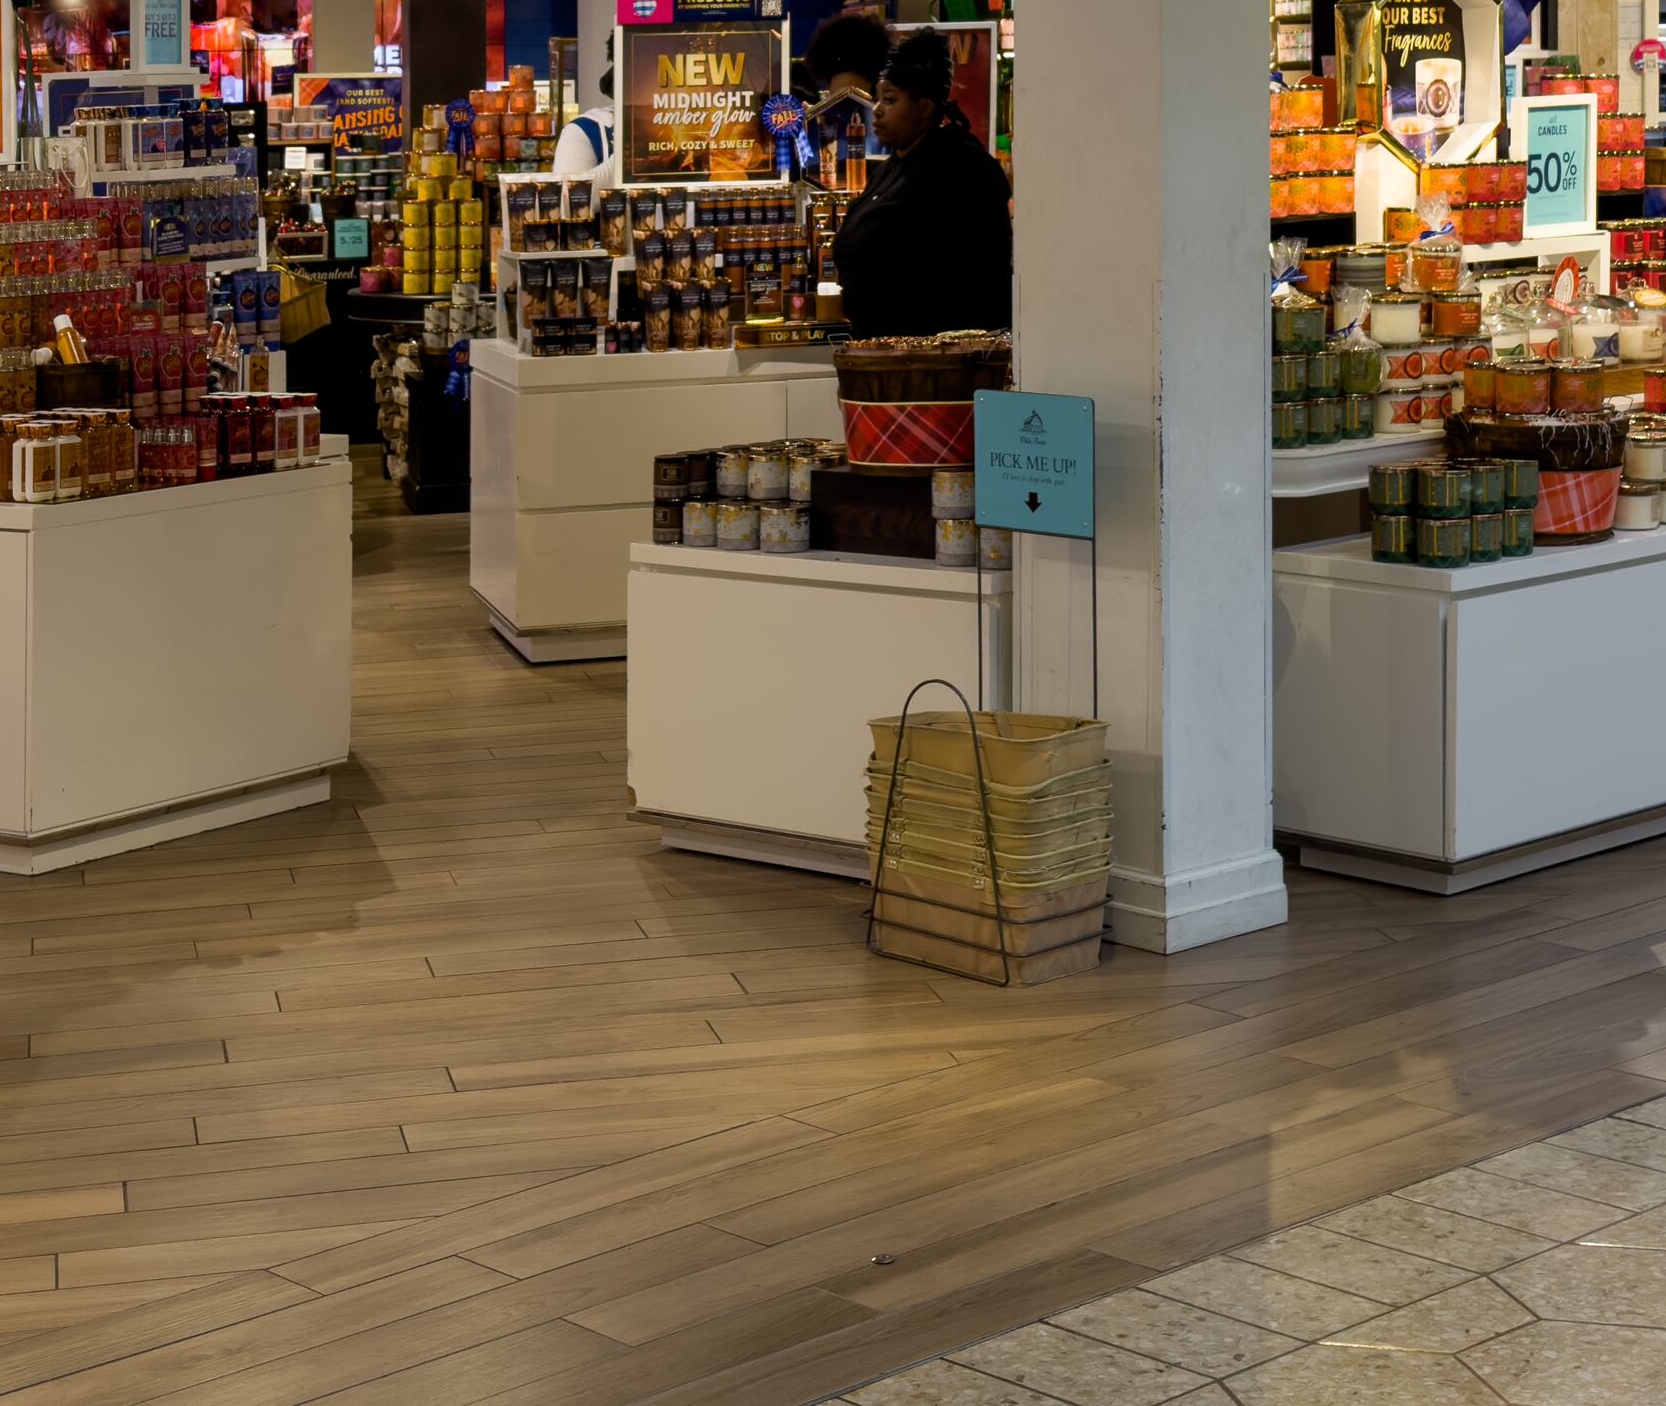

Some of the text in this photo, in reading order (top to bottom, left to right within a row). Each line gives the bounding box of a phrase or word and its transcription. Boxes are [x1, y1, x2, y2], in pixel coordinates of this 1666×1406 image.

[1382, 7, 1445, 25] OUR BEST
[145, 22, 177, 38] FREE
[1385, 25, 1452, 68] Fragrances
[658, 52, 746, 88] NEW
[346, 89, 385, 97] OUR BEST
[653, 91, 754, 109] MIDNIGHT
[334, 107, 396, 130] ANSING
[653, 104, 756, 137] amber glow
[771, 112, 798, 128] FALL
[1538, 125, 1568, 136] CANDLES
[649, 139, 755, 153] RICH, COZY & SWEET
[1527, 151, 1578, 195] 50%
[1562, 177, 1578, 191] OFF
[753, 263, 774, 272] NEW
[791, 332, 800, 340] &
[801, 330, 826, 340] PLAY
[990, 452, 1077, 475] PICK ME UP!
